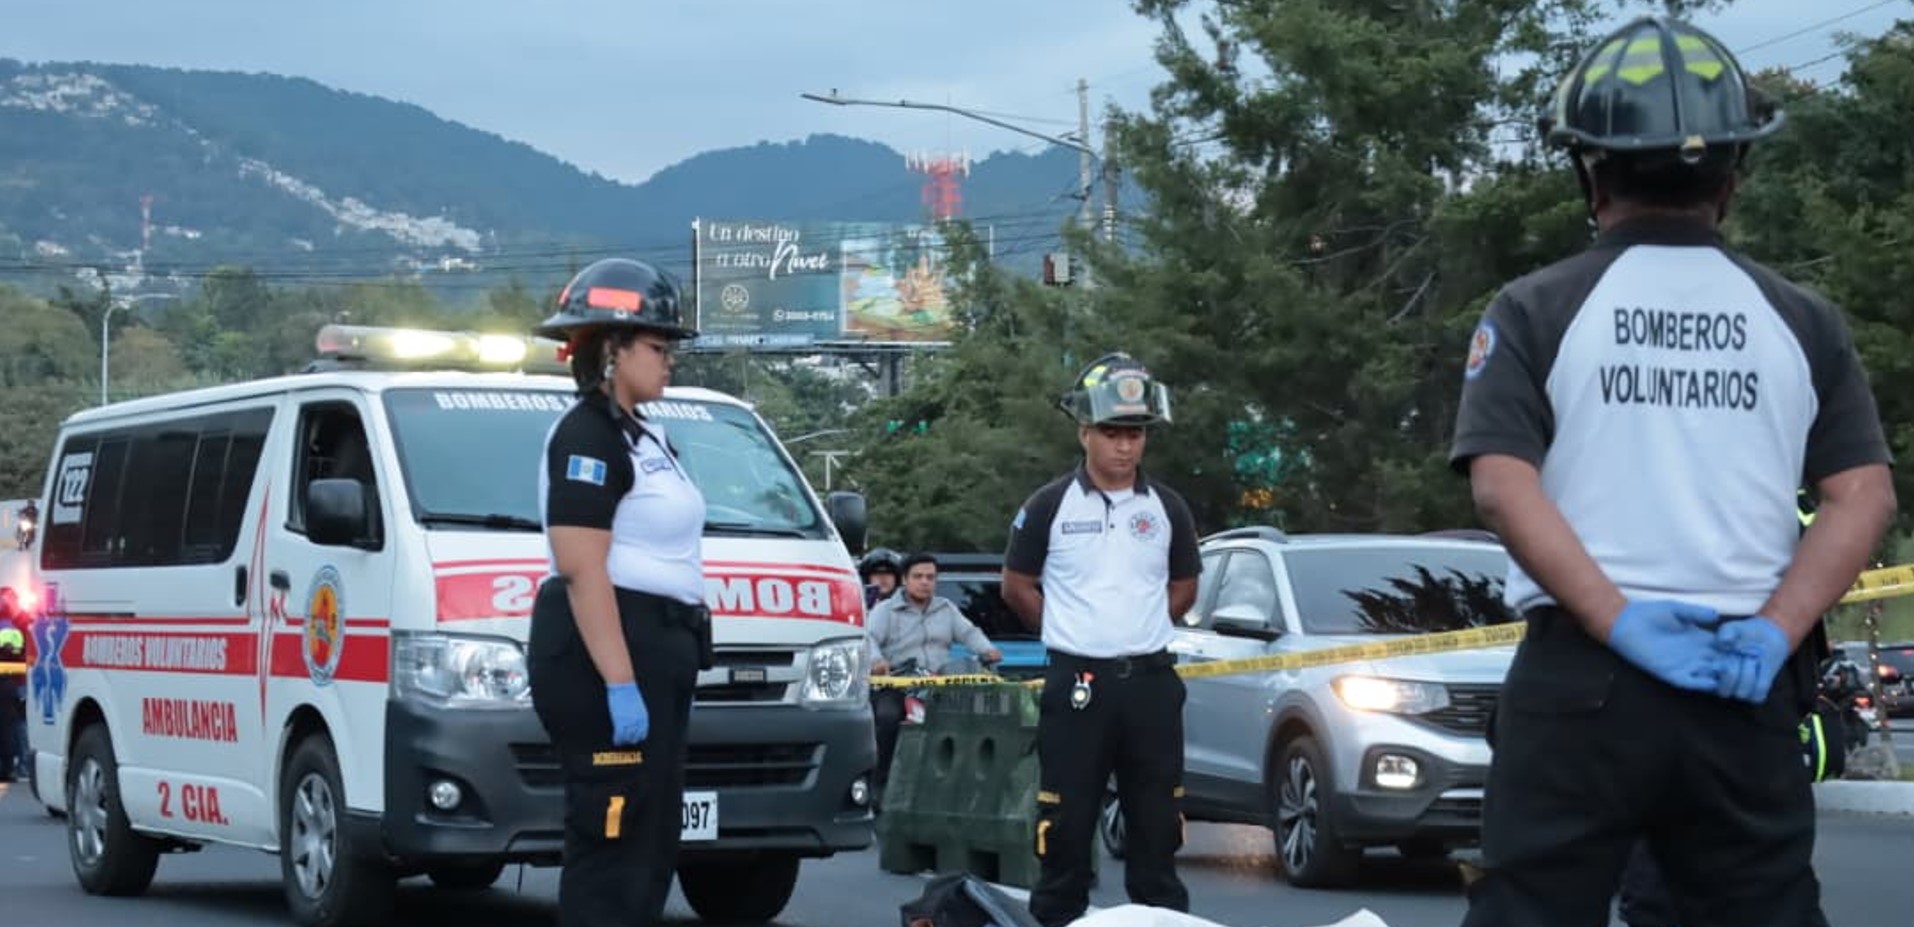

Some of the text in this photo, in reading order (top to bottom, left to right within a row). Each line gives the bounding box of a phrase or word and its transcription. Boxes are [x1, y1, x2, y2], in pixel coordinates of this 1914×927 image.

[1614, 308, 1748, 351] BOMBEROS
[434, 392, 566, 411] BOMBEROS
[1600, 364, 1759, 411] VOLUNTARIOS
[83, 634, 228, 670] BOMBEROS VOLUNTARIOS
[143, 697, 239, 742] AMBULANCIA
[158, 781, 229, 826] 2 CIA.
